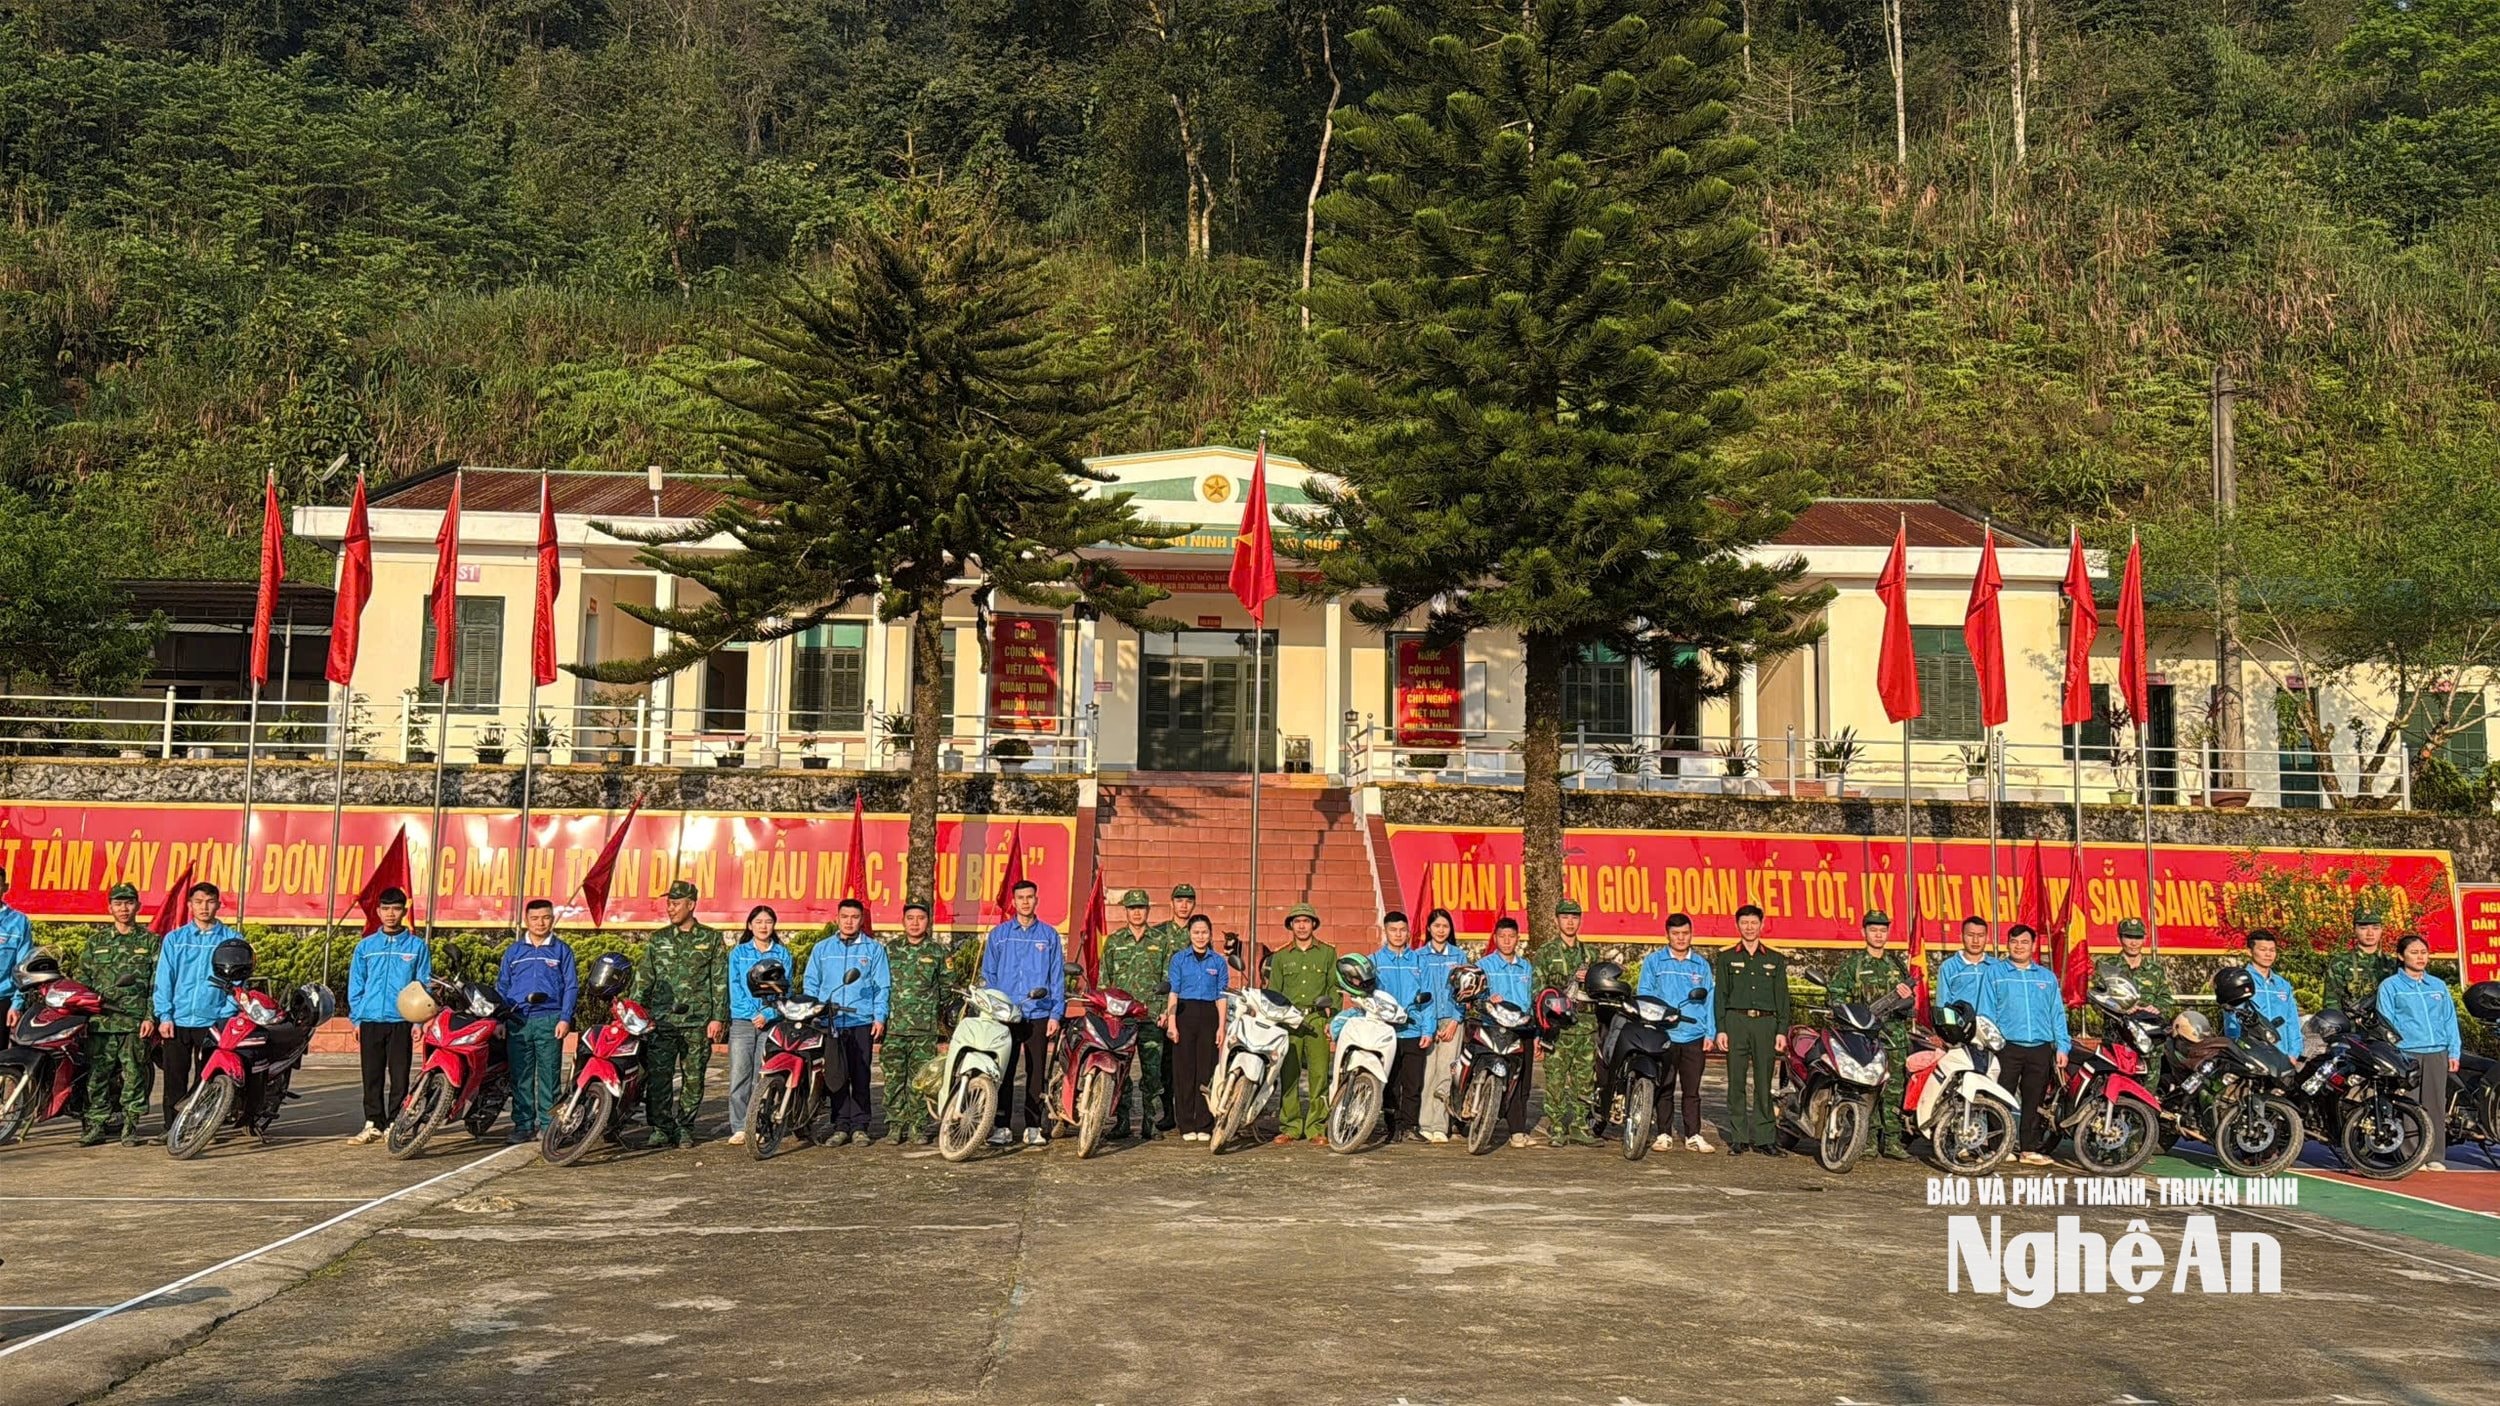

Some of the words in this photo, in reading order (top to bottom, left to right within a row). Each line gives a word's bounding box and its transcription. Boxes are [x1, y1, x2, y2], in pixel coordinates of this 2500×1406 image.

[1190, 535, 1228, 548] NINH
[458, 565, 476, 580] S1
[1004, 644, 1027, 659] CỘNG
[1005, 662, 1022, 679] VIỆT
[1024, 664, 1043, 676] NAM
[1408, 664, 1432, 677] CỘNG
[1000, 682, 1027, 694] QUANG
[1028, 682, 1048, 694] VINH
[1406, 691, 1425, 704] CHỦ
[1426, 692, 1453, 704] NGHĨA
[1409, 707, 1427, 719] VIỆT
[1429, 708, 1450, 718] NAM
[30, 827, 95, 891] TÂM
[99, 829, 161, 892] XÂY
[261, 839, 327, 895] ĐƠN
[1597, 847, 1658, 920] GIỎI,
[1665, 856, 1739, 916] ĐOÀN
[1745, 851, 1793, 918] KẾT
[1800, 852, 1855, 925] TỐT,
[1860, 854, 1895, 918] KỶ
[1904, 863, 1963, 932] UẬT
[2088, 858, 2142, 927] SẴN
[2151, 868, 2220, 928] SÀNG
[2471, 917, 2497, 931] DÂN
[2471, 951, 2497, 965] DÂN
